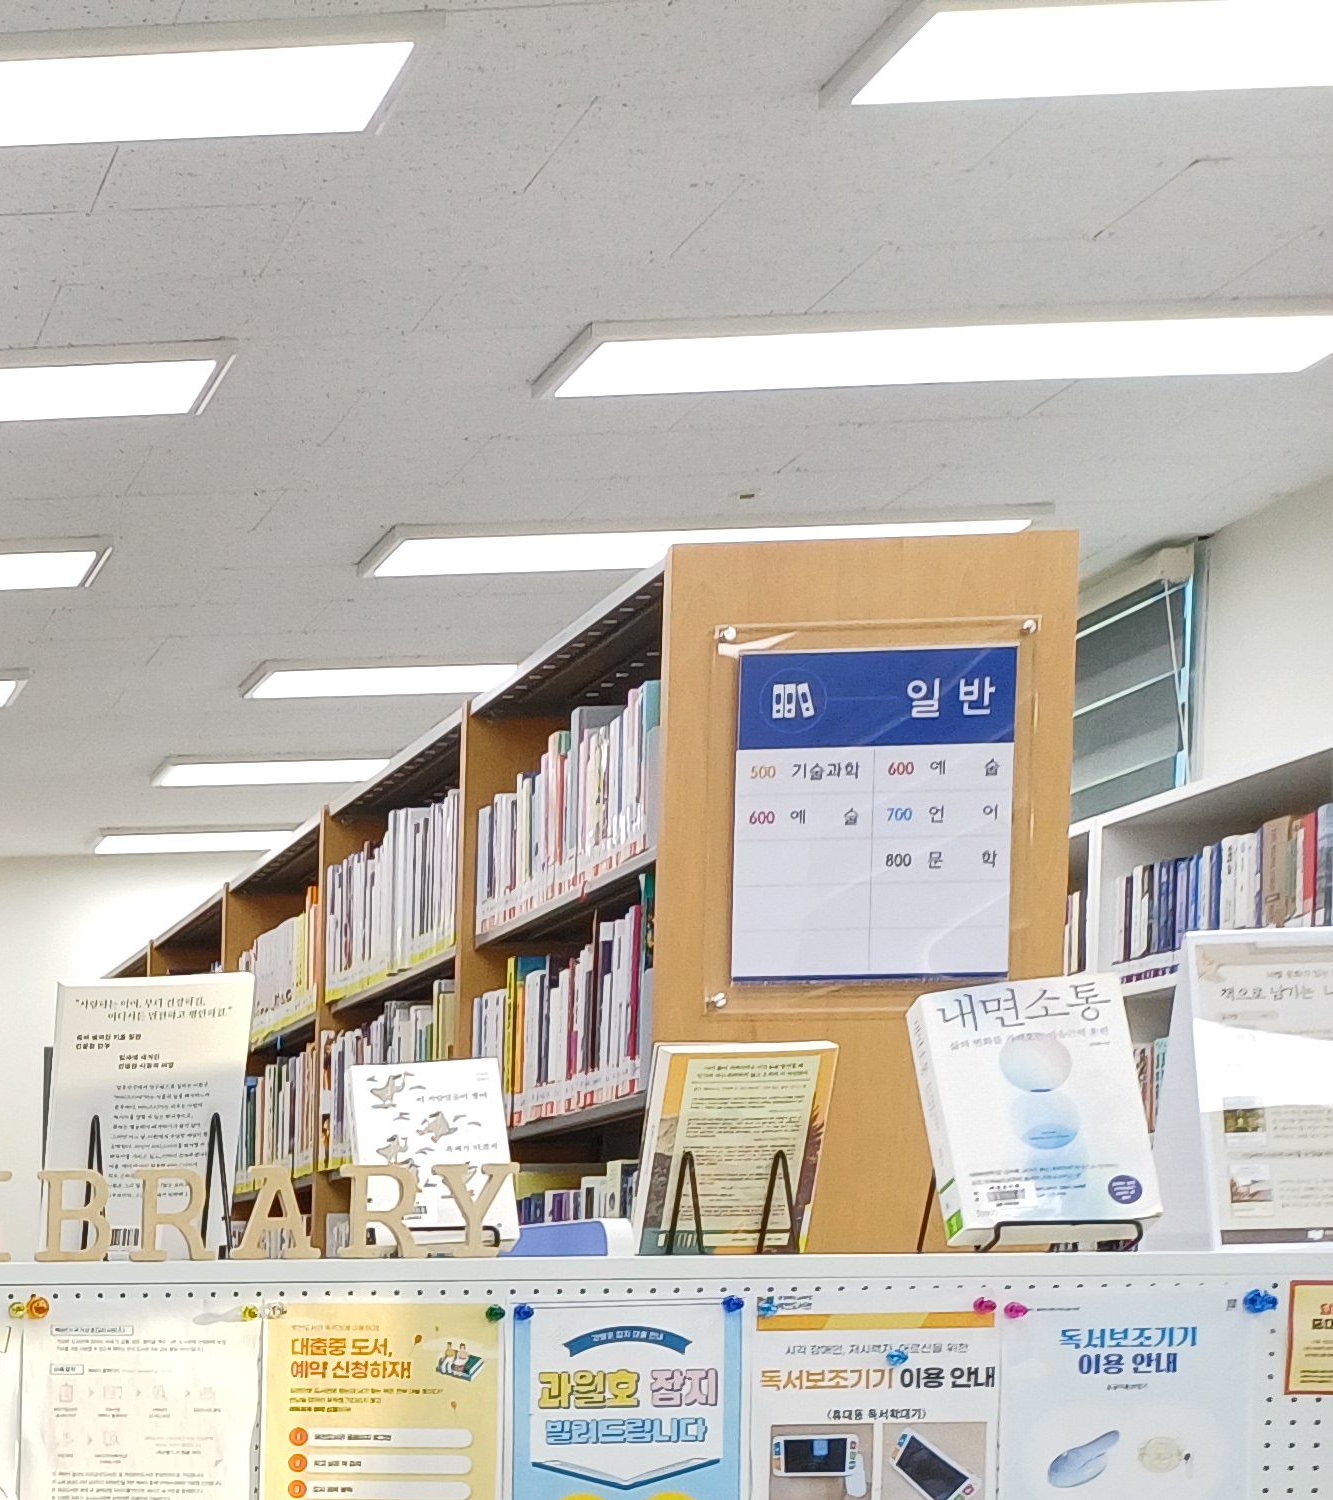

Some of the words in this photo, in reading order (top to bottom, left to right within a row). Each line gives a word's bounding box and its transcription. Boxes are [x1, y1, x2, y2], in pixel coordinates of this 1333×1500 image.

[751, 765, 776, 779] 500
[792, 761, 859, 781] 기술과학
[888, 762, 914, 775] 600
[749, 811, 775, 824] 600
[887, 808, 912, 821] 700
[885, 853, 911, 868] 800
[936, 982, 1111, 1031] 내면소통
[291, 1338, 346, 1356] 대출중
[351, 1338, 392, 1357] 도서,
[1059, 1327, 1198, 1349] 독서보조기기
[291, 1361, 328, 1379] 예약
[1078, 1353, 1125, 1375] 이용
[1132, 1353, 1178, 1373] 안내
[538, 1369, 640, 1409] 과월호
[650, 1368, 719, 1407] 잡지
[760, 1368, 893, 1391] 독서보조기기
[900, 1367, 945, 1389] 이용
[950, 1366, 995, 1389] 안내
[545, 1417, 708, 1445] 빌려드립니다
